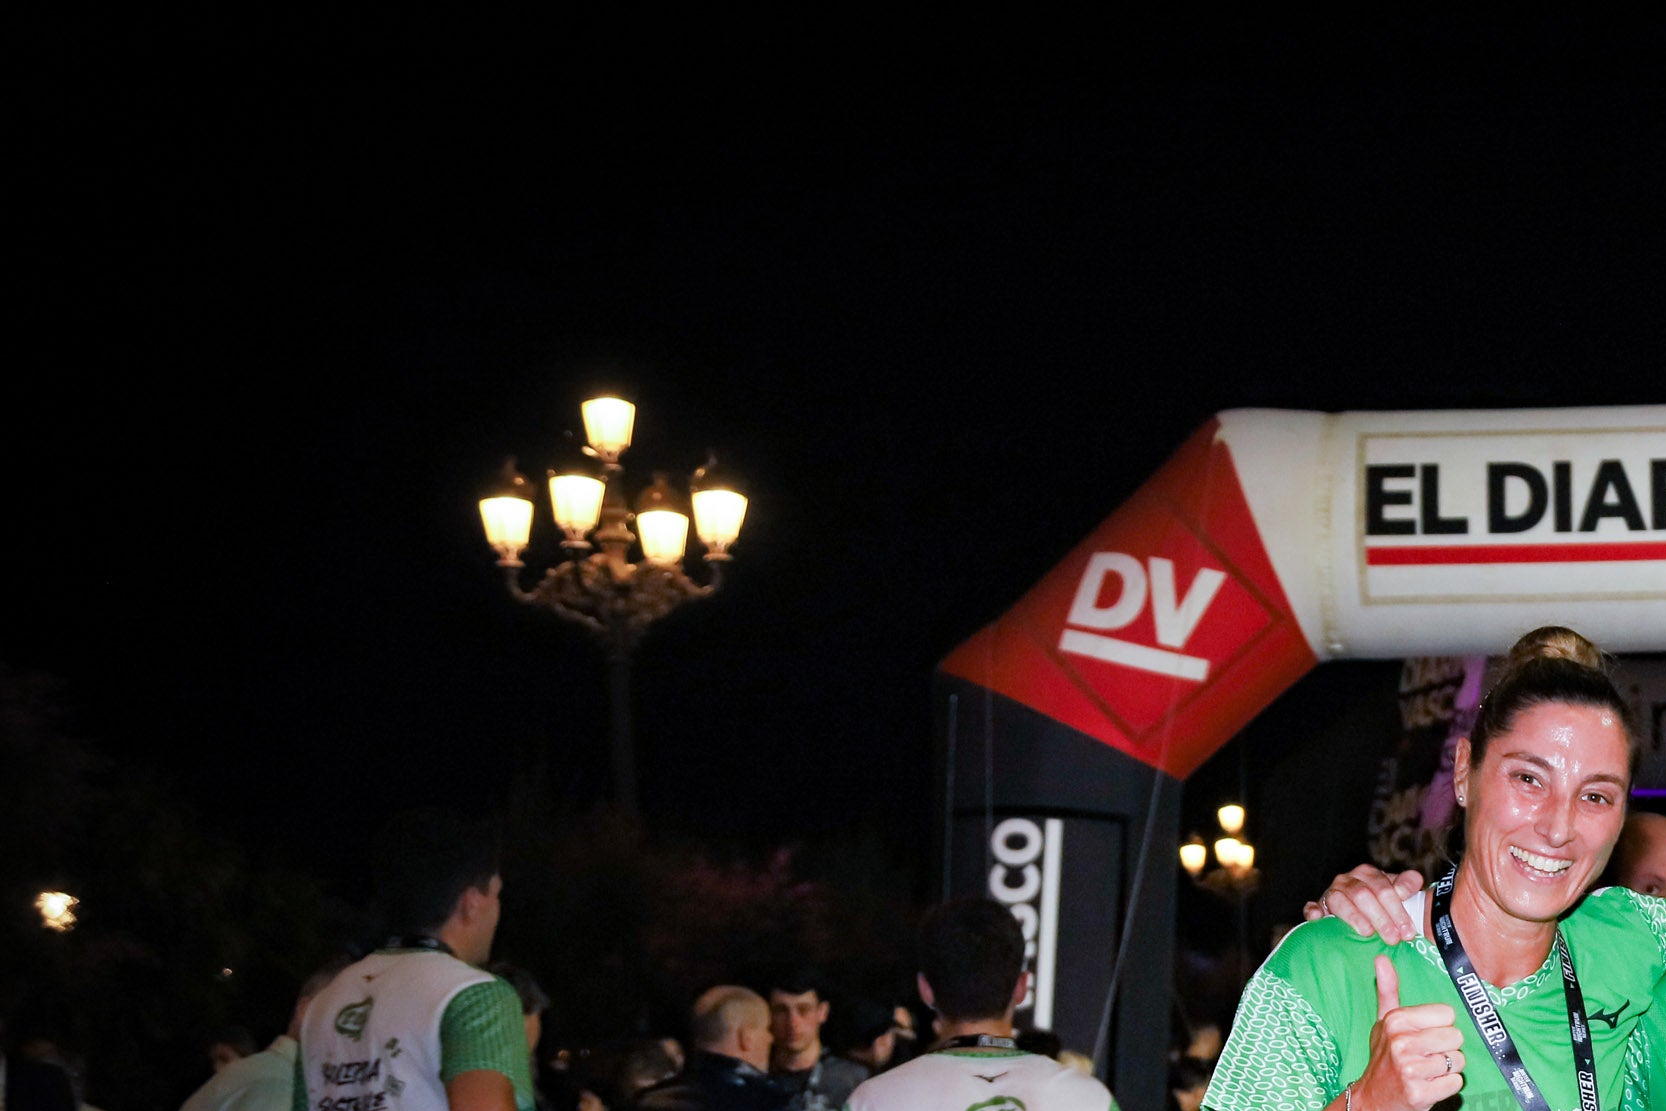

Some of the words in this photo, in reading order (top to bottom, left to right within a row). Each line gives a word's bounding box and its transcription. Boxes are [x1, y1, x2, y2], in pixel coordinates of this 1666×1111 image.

[1364, 463, 1469, 537] EL
[1067, 551, 1227, 649] DV
[1457, 972, 1507, 1045] FINISHER
